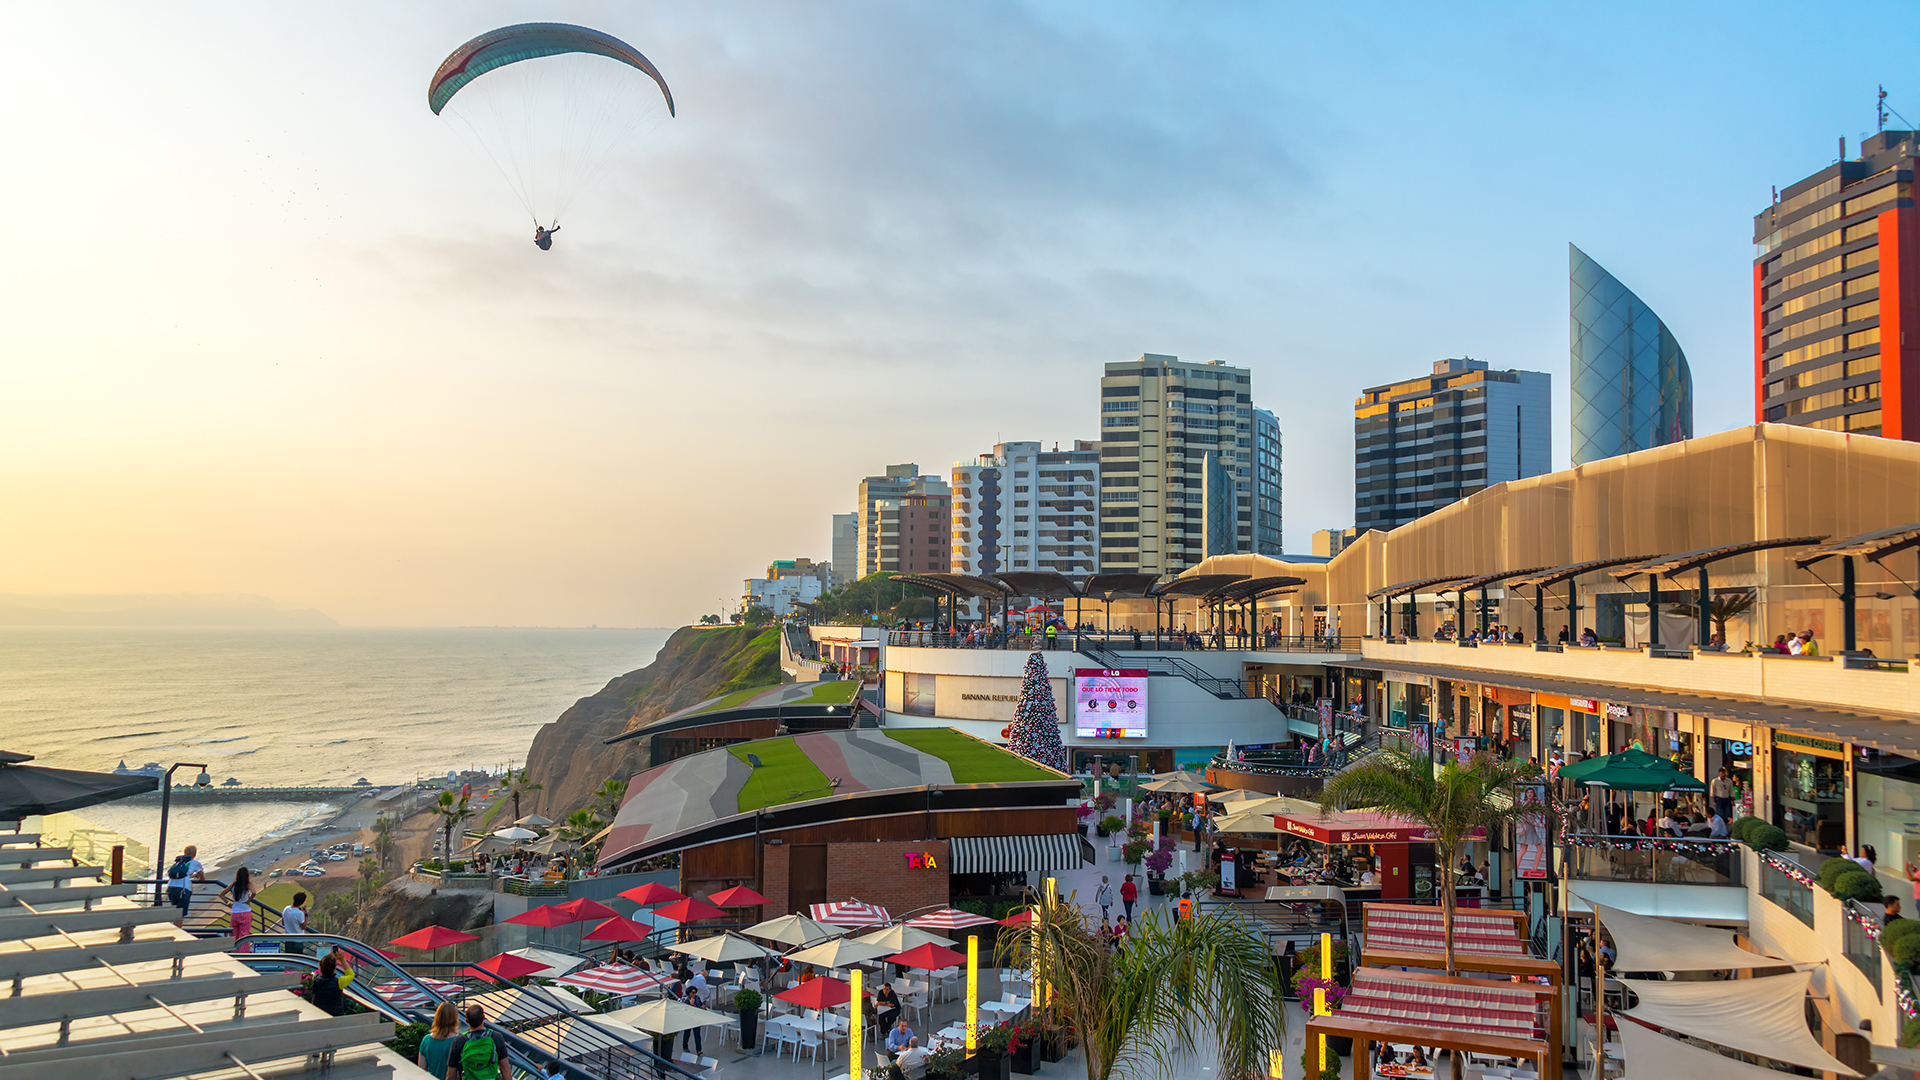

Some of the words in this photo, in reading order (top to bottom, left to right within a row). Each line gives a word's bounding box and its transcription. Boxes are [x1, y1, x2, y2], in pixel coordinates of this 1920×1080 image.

[961, 693, 990, 701] BANANA
[992, 694, 1019, 702] REPUBL
[1774, 732, 1812, 747] STARBUCKS
[1813, 740, 1840, 752] COFFEE
[1351, 832, 1366, 841] Juan
